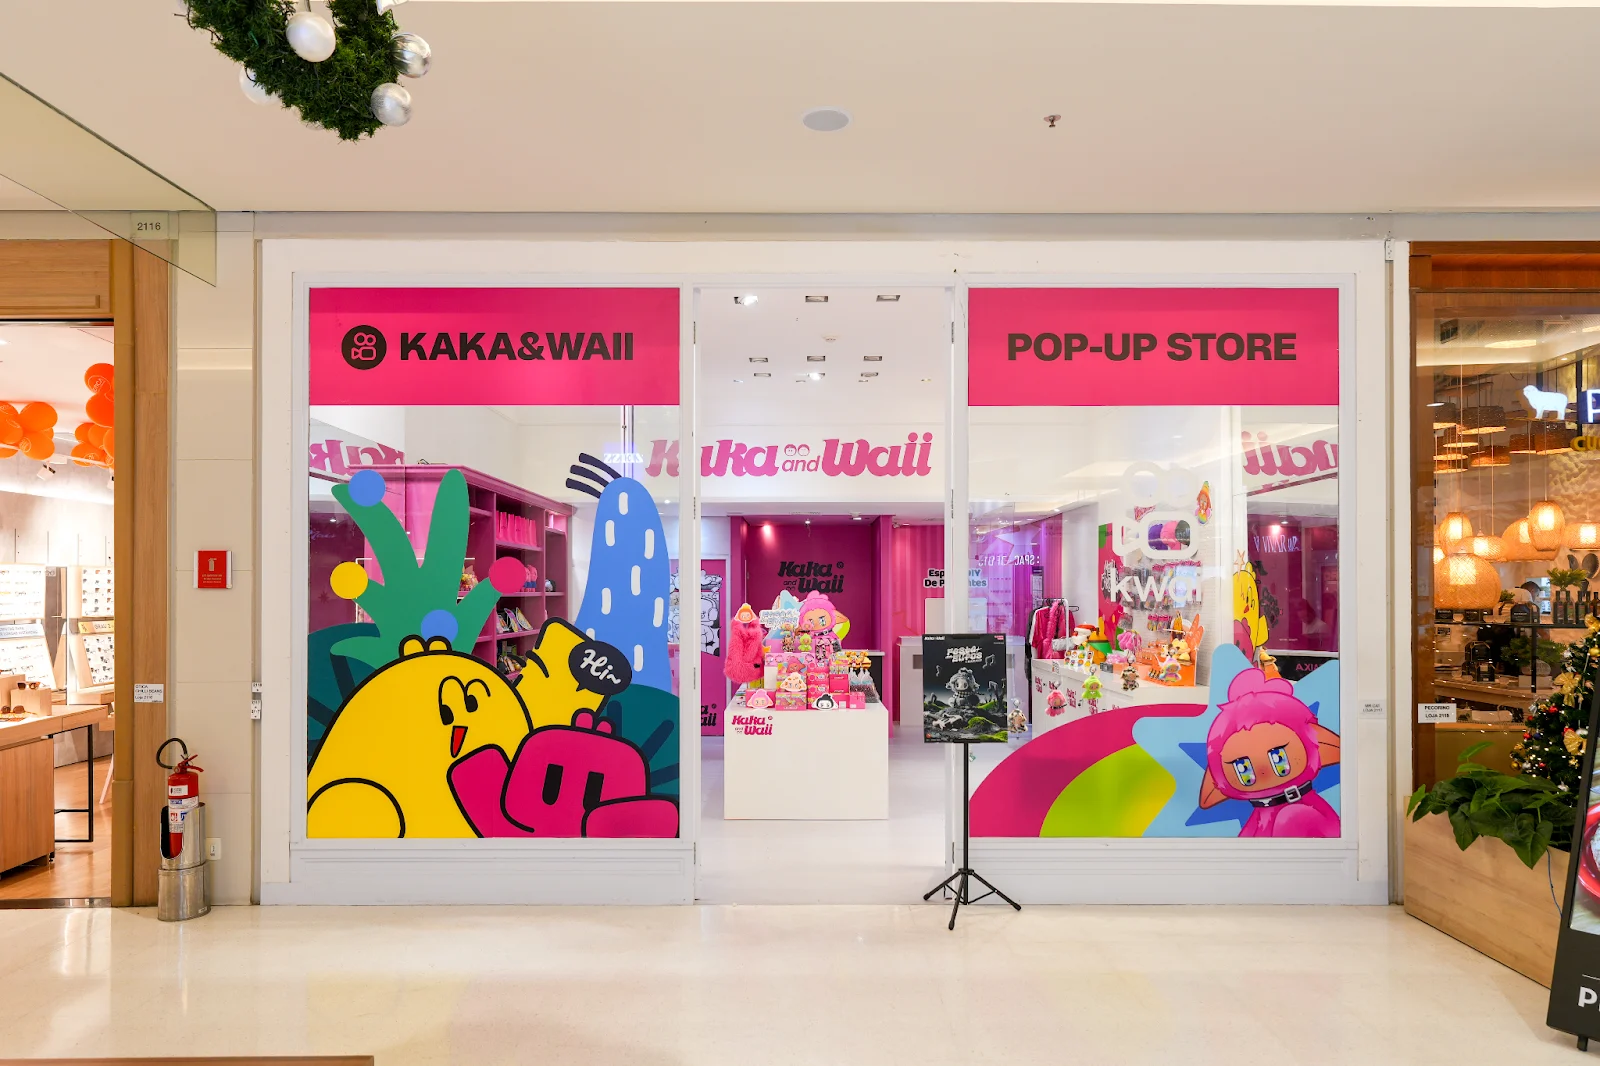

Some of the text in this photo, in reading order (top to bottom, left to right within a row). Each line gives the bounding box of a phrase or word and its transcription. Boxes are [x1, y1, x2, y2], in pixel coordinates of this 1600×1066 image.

[137, 222, 161, 231] 2116
[400, 331, 634, 361] KAKA&WAII
[1008, 332, 1297, 361] POP-UP STORE
[781, 455, 821, 473] and
[821, 432, 933, 477] Waii
